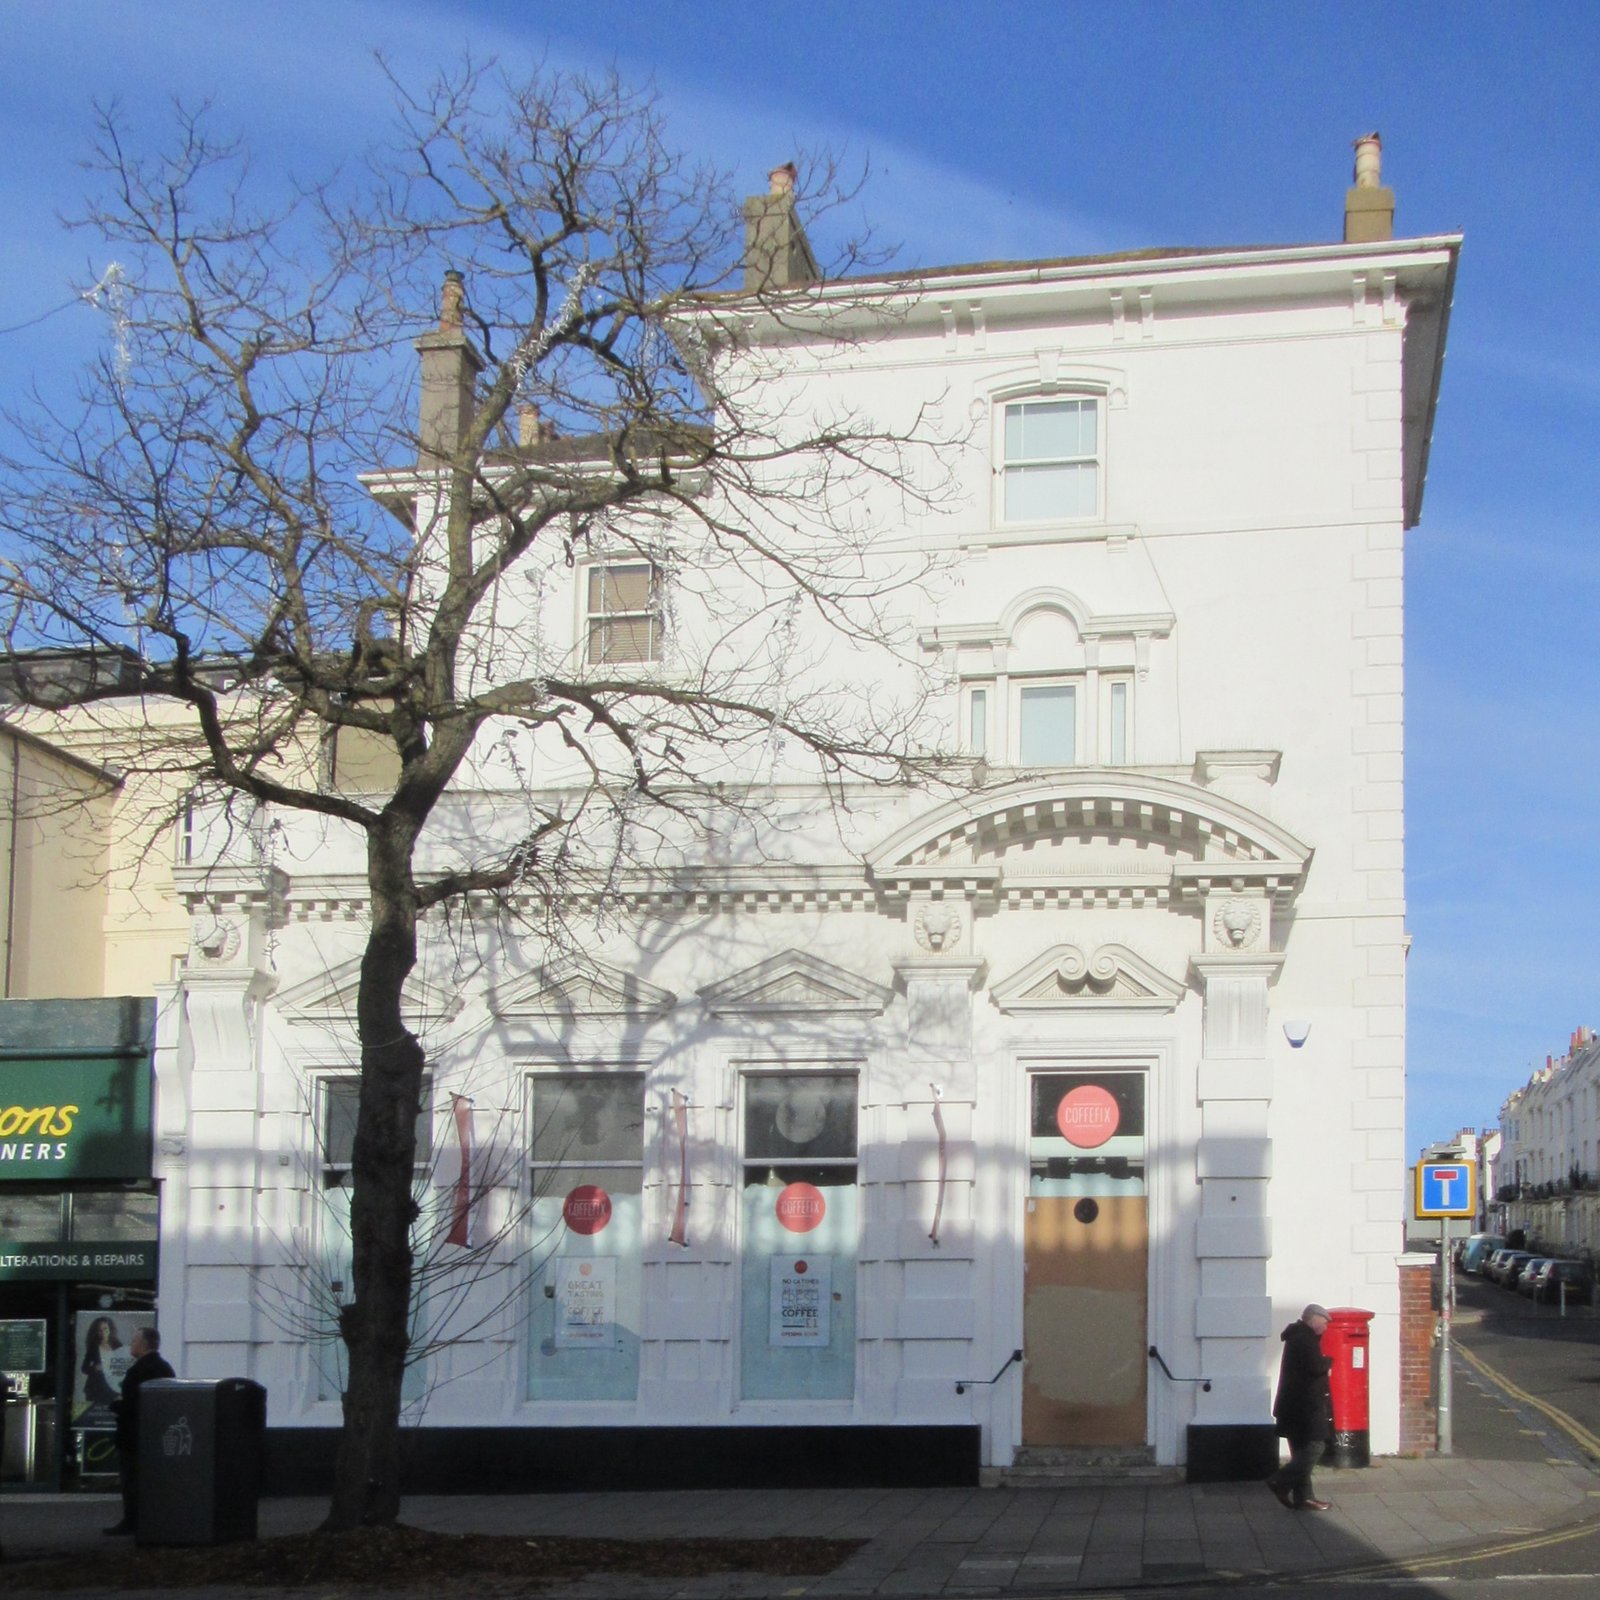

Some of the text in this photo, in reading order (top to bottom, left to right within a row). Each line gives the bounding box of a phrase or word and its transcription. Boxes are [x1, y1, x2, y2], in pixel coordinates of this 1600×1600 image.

[0, 1254, 145, 1267] LTERATIONS & REPAIRS
[567, 1280, 604, 1290] GREAT
[782, 1309, 818, 1318] COFFEE
